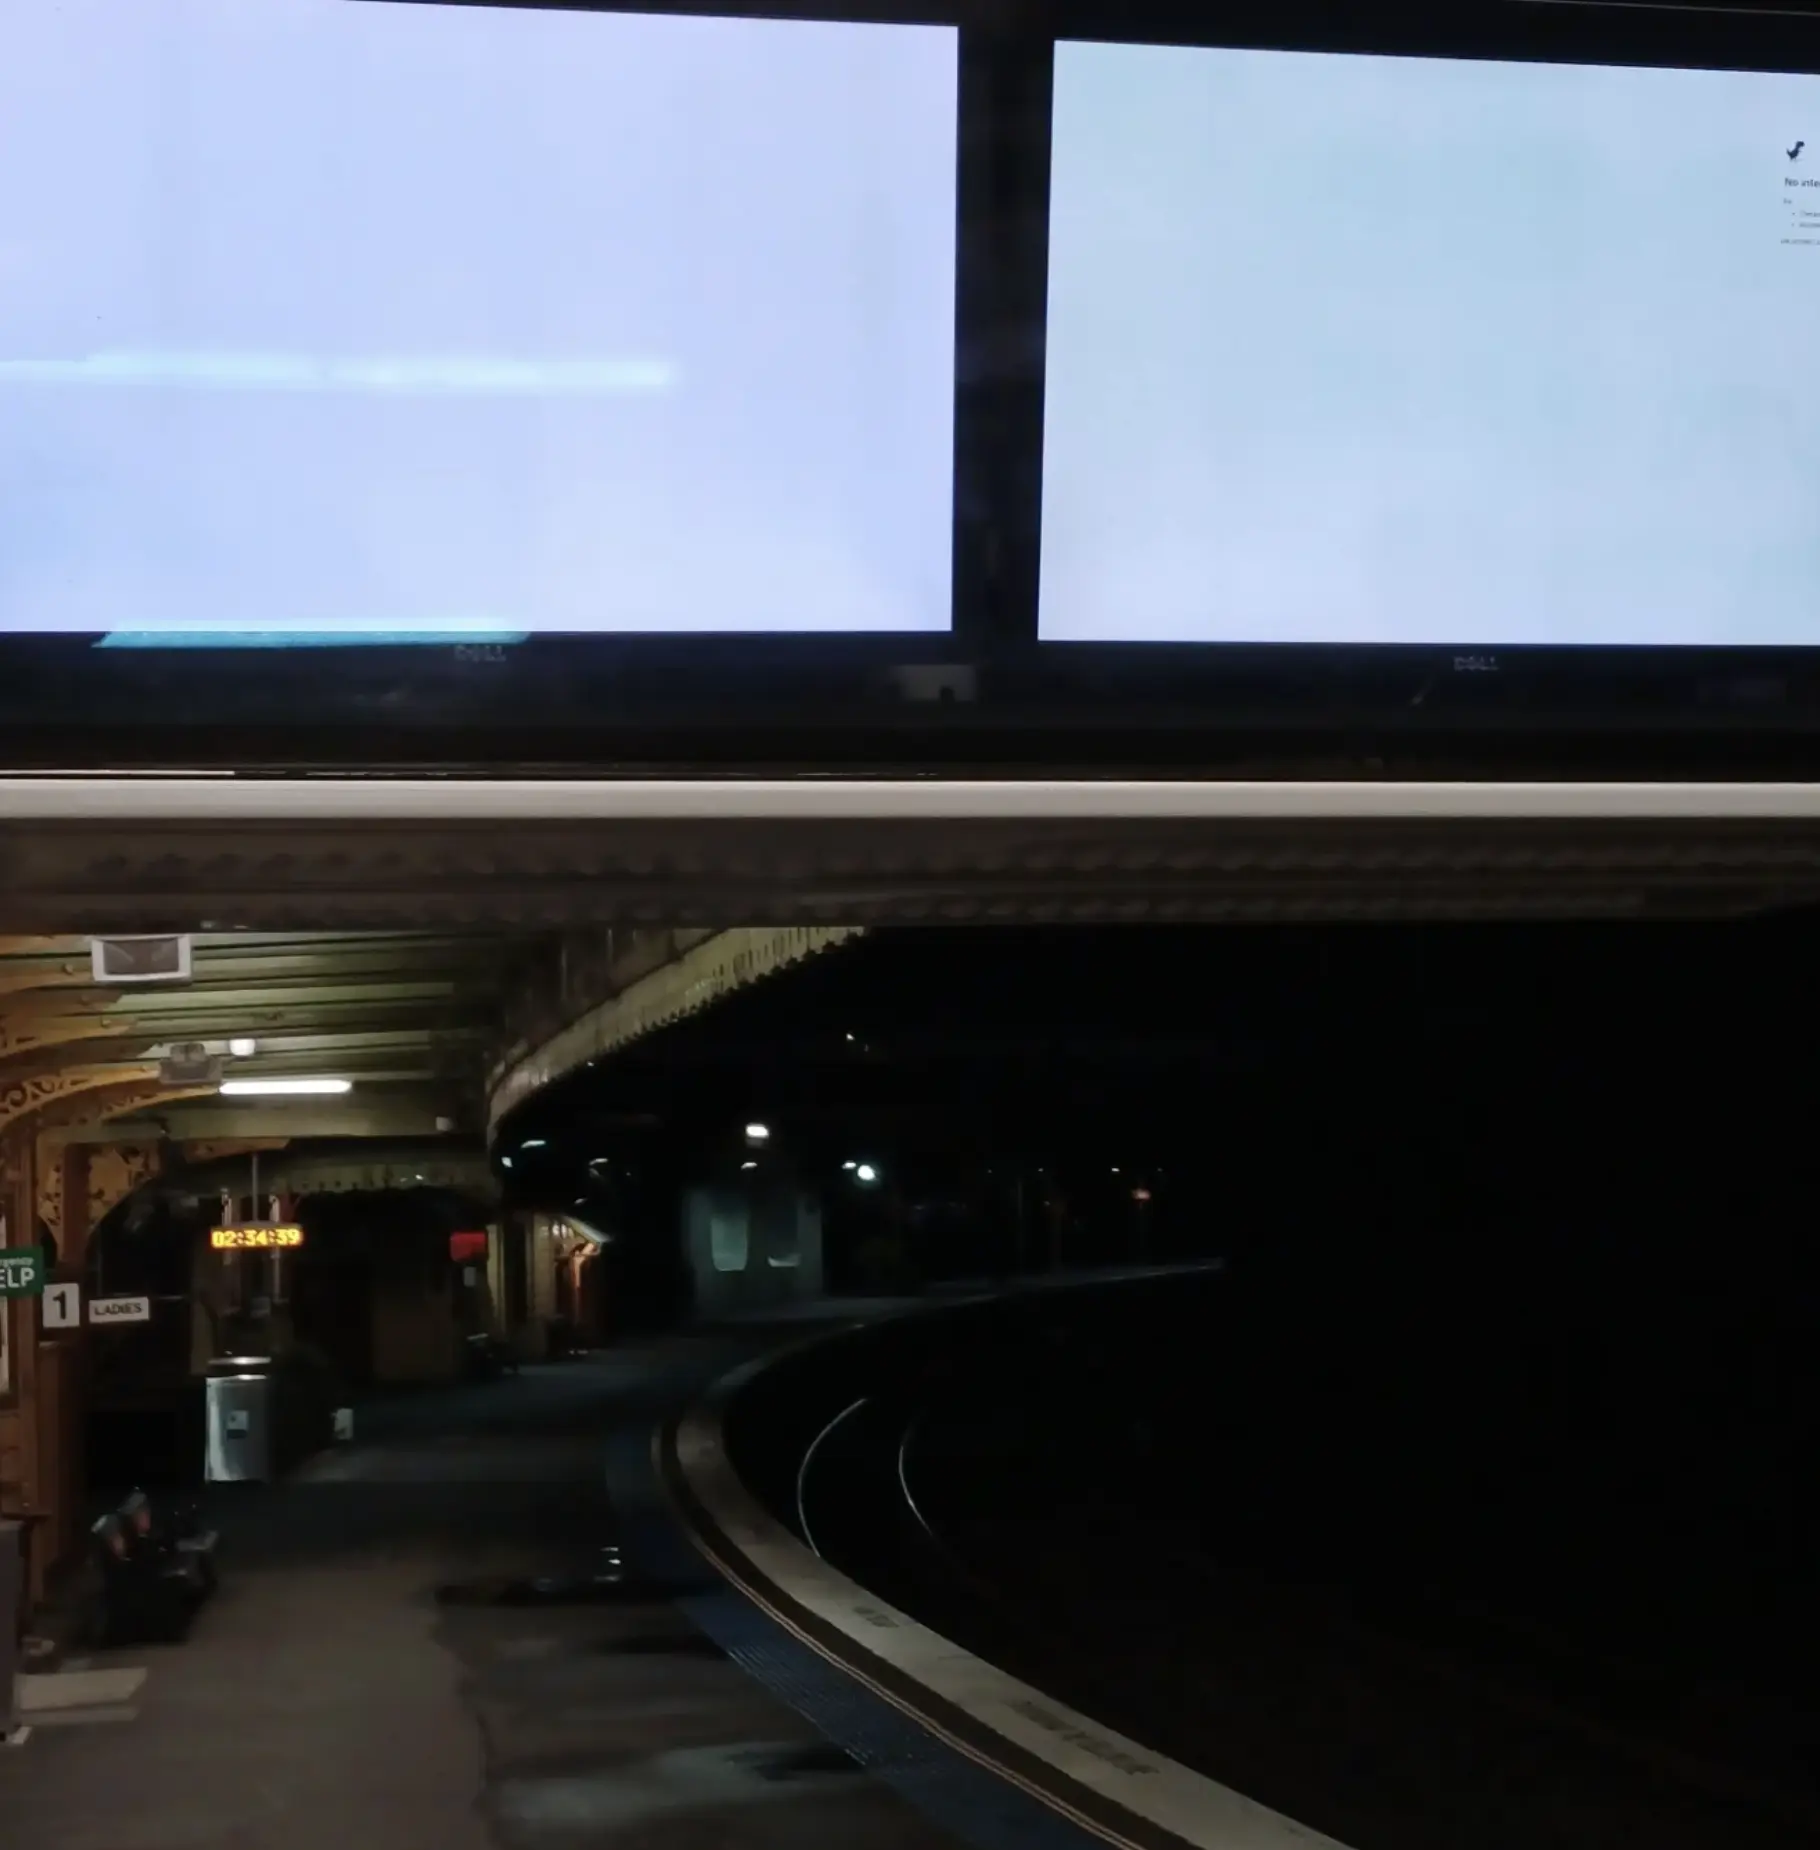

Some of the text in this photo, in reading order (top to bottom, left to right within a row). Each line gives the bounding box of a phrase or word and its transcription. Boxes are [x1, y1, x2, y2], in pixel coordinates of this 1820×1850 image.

[1785, 178, 1799, 187] No
[53, 1290, 66, 1319] 1
[95, 1303, 143, 1316] LADIES
